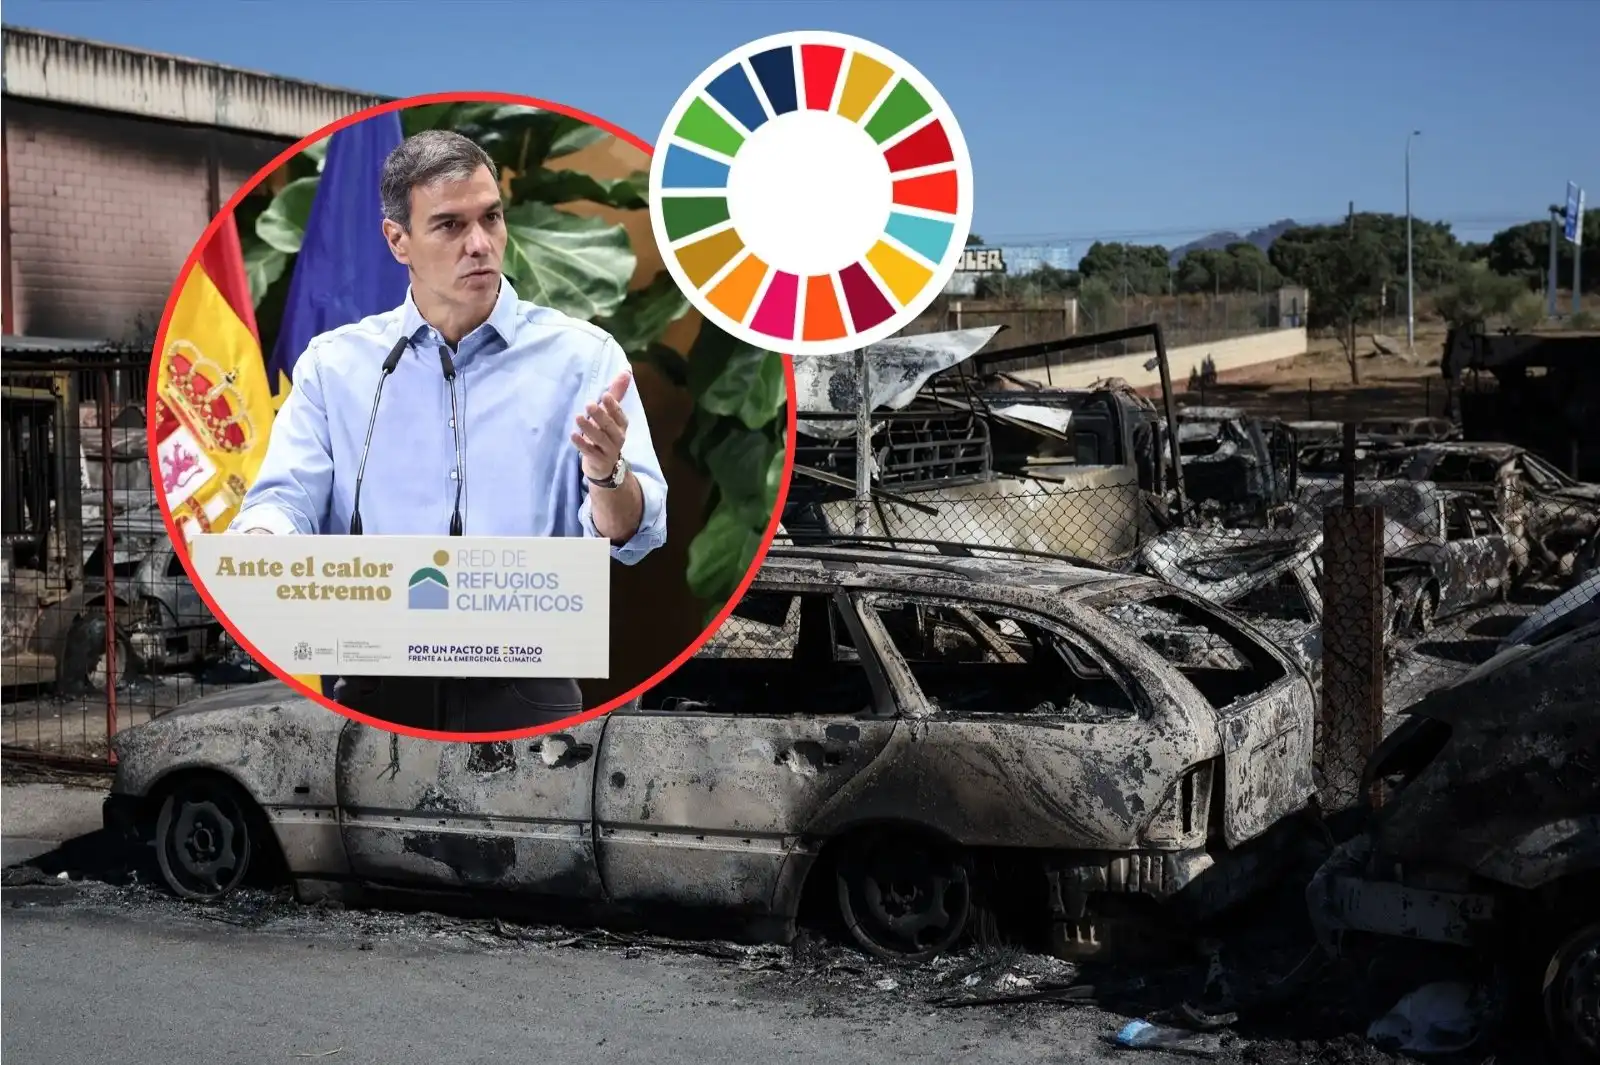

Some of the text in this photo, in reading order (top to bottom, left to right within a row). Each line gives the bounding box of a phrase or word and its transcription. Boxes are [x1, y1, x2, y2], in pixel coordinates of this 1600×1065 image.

[216, 556, 393, 578] Ante el calor
[457, 550, 527, 567] RED DE
[456, 572, 559, 590] REFUGIOS
[276, 581, 392, 601] extremo
[456, 590, 583, 612] CLIMÁTICOS
[408, 645, 543, 655] POR UN PACTO DE ESTADO
[454, 655, 502, 663] EMERGENCIA
